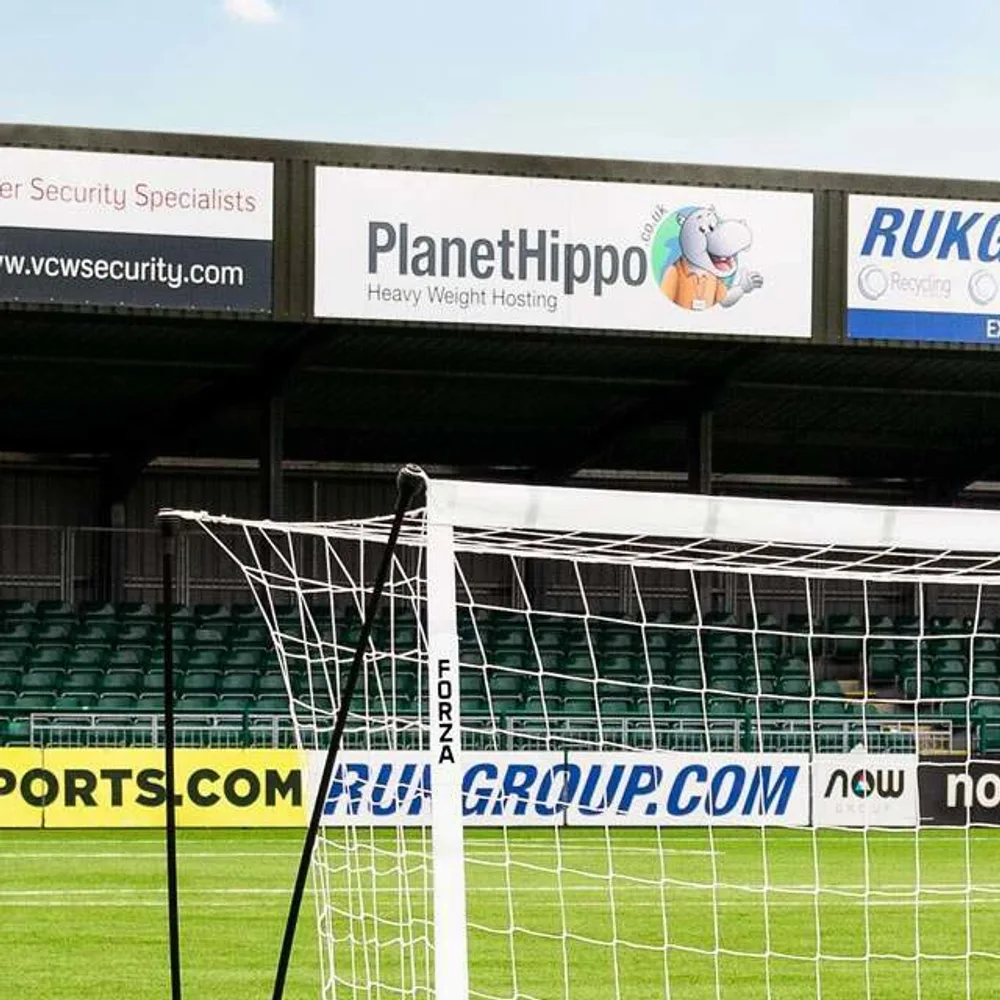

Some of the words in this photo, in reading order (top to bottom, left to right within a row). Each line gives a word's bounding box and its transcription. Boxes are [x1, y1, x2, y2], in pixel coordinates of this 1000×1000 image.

[31, 177, 126, 211] Security
[135, 184, 256, 212] Specialists
[0, 254, 243, 288] w.vcwsecurity.com
[368, 221, 647, 296] PlanetHippo
[368, 284, 422, 304] Heavy
[426, 286, 486, 308] Weight
[492, 290, 558, 312] Hosting
[891, 273, 951, 299] Recycling
[437, 659, 455, 764] FORZA
[323, 763, 800, 816] RUGROUP.COM
[824, 769, 904, 798] now
